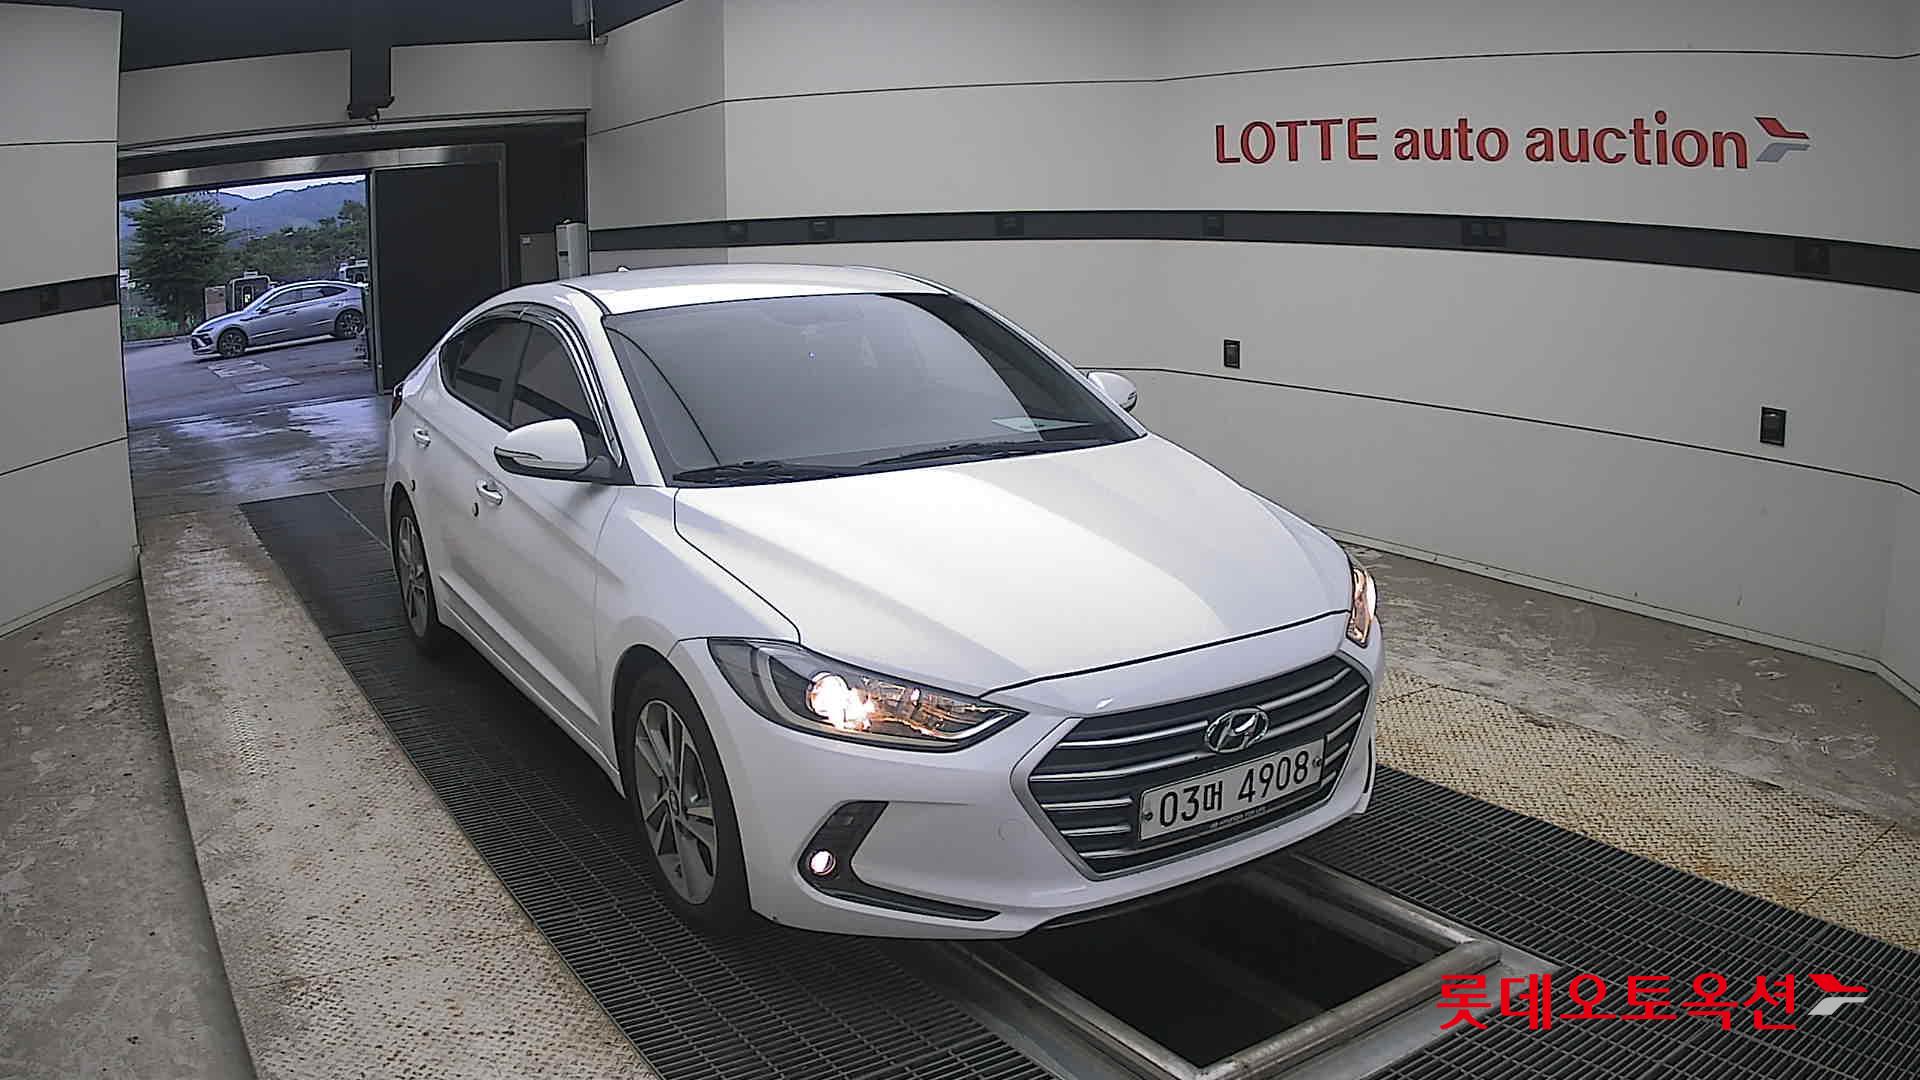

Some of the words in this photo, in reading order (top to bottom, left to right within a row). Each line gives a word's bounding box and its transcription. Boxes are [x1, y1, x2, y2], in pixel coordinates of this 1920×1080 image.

[1215, 118, 1377, 164] LOTTE
[1393, 118, 1510, 162] auto
[1525, 110, 1749, 169] auction
[1159, 780, 1223, 827] 03머
[1237, 750, 1310, 803] 4908
